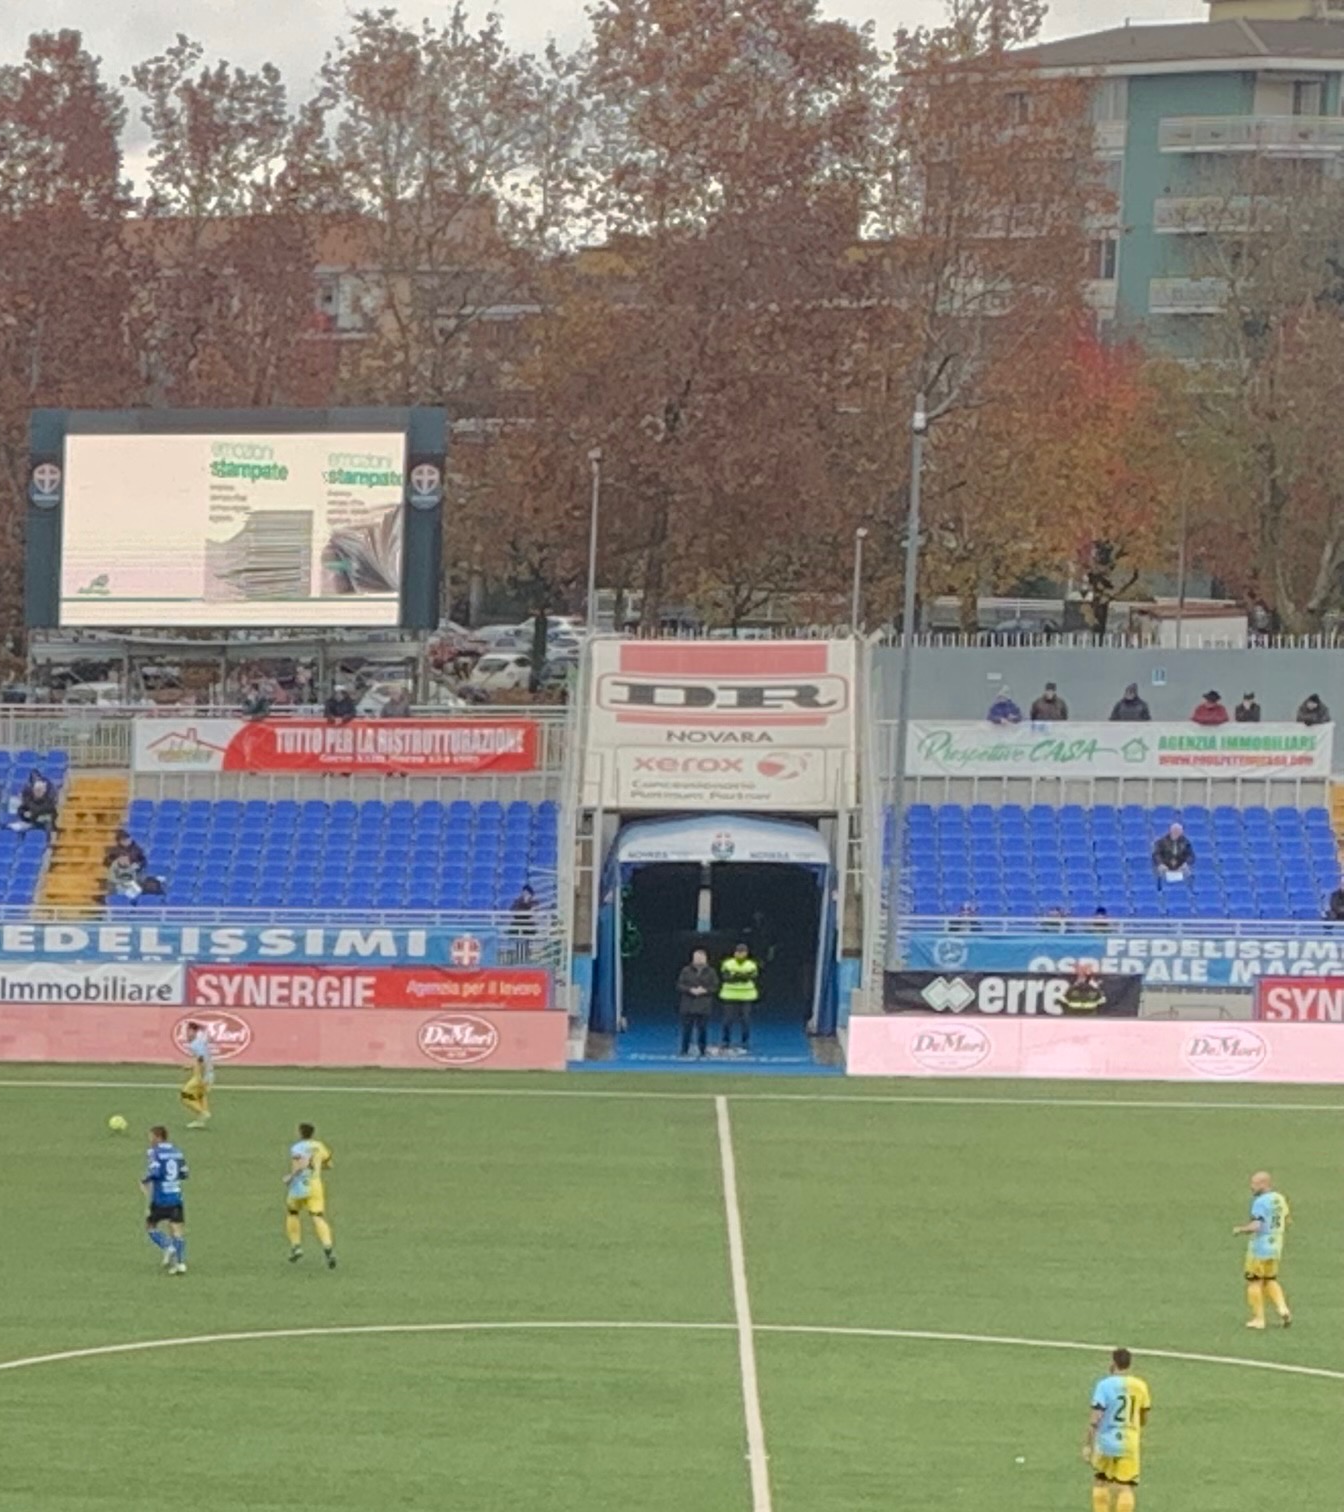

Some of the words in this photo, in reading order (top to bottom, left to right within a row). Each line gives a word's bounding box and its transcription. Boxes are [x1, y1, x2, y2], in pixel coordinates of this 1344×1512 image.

[211, 460, 288, 484] stampate
[275, 728, 322, 754] TUTTO
[324, 728, 354, 754] PER
[356, 728, 378, 754] LA
[665, 730, 774, 744] NOVARA
[1028, 737, 1100, 765] CASA
[633, 756, 744, 773] xerox
[1028, 956, 1208, 983] OSEDALE
[0, 975, 173, 1001] Immobiliare
[195, 974, 378, 1008] SYNERGIE
[461, 982, 486, 999] per
[977, 975, 1080, 1016] erre
[164, 1158, 178, 1182] 9
[1113, 1394, 1137, 1424] 21
